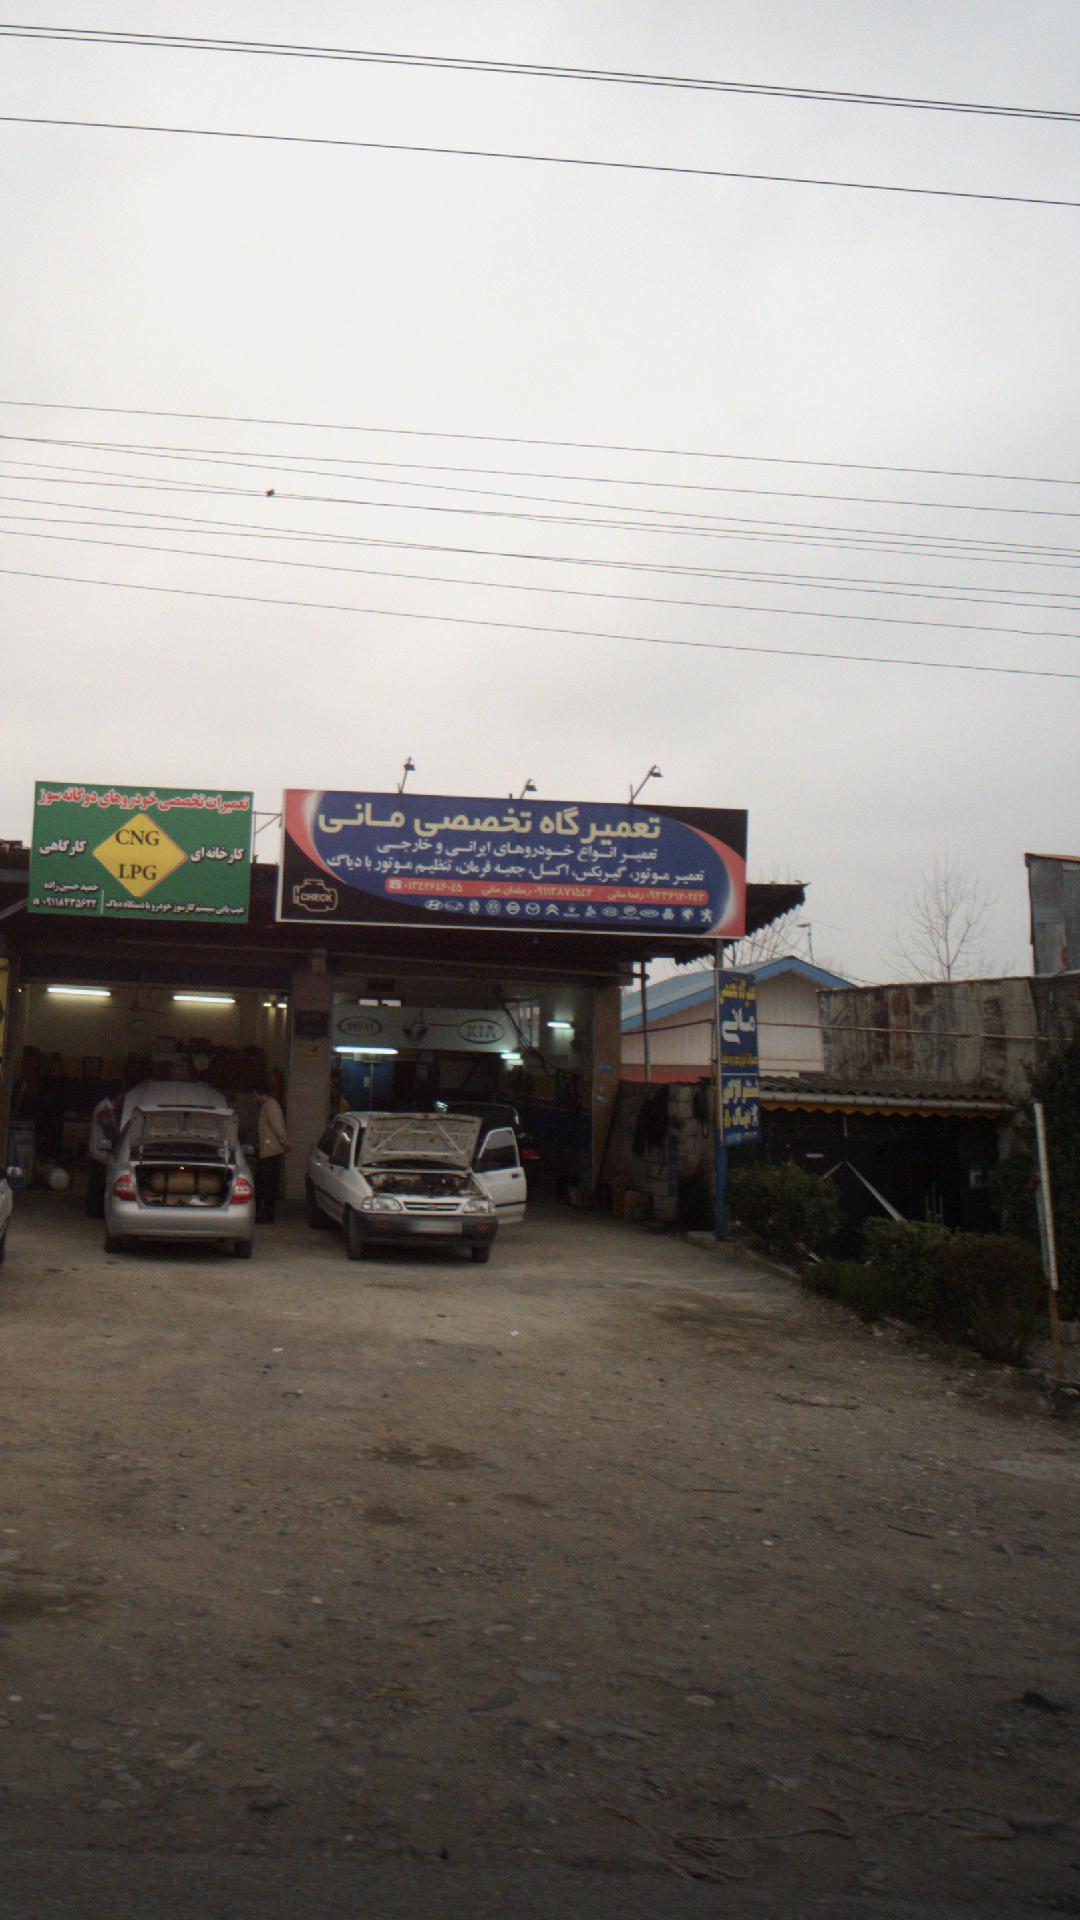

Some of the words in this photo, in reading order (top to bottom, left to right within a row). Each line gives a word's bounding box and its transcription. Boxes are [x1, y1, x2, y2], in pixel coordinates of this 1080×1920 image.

[158, 793, 206, 811] تخصصی
[206, 795, 250, 814] تعمیرات
[318, 803, 406, 833] مانی
[413, 808, 532, 837] تخصصی
[115, 829, 160, 846] CNG
[376, 838, 433, 854] خارجی
[435, 841, 443, 855] و
[445, 840, 491, 857] ایرانی
[493, 842, 575, 860] خودروهای
[577, 846, 617, 862] انواع
[620, 848, 658, 863] تعمیر
[119, 864, 157, 880] LPG
[374, 857, 413, 874] موتور
[415, 858, 453, 874] تنظیم
[494, 863, 526, 877] جعبه
[672, 870, 705, 885] تعمیر
[301, 893, 333, 902] CHECK
[721, 1008, 756, 1044] مانی
